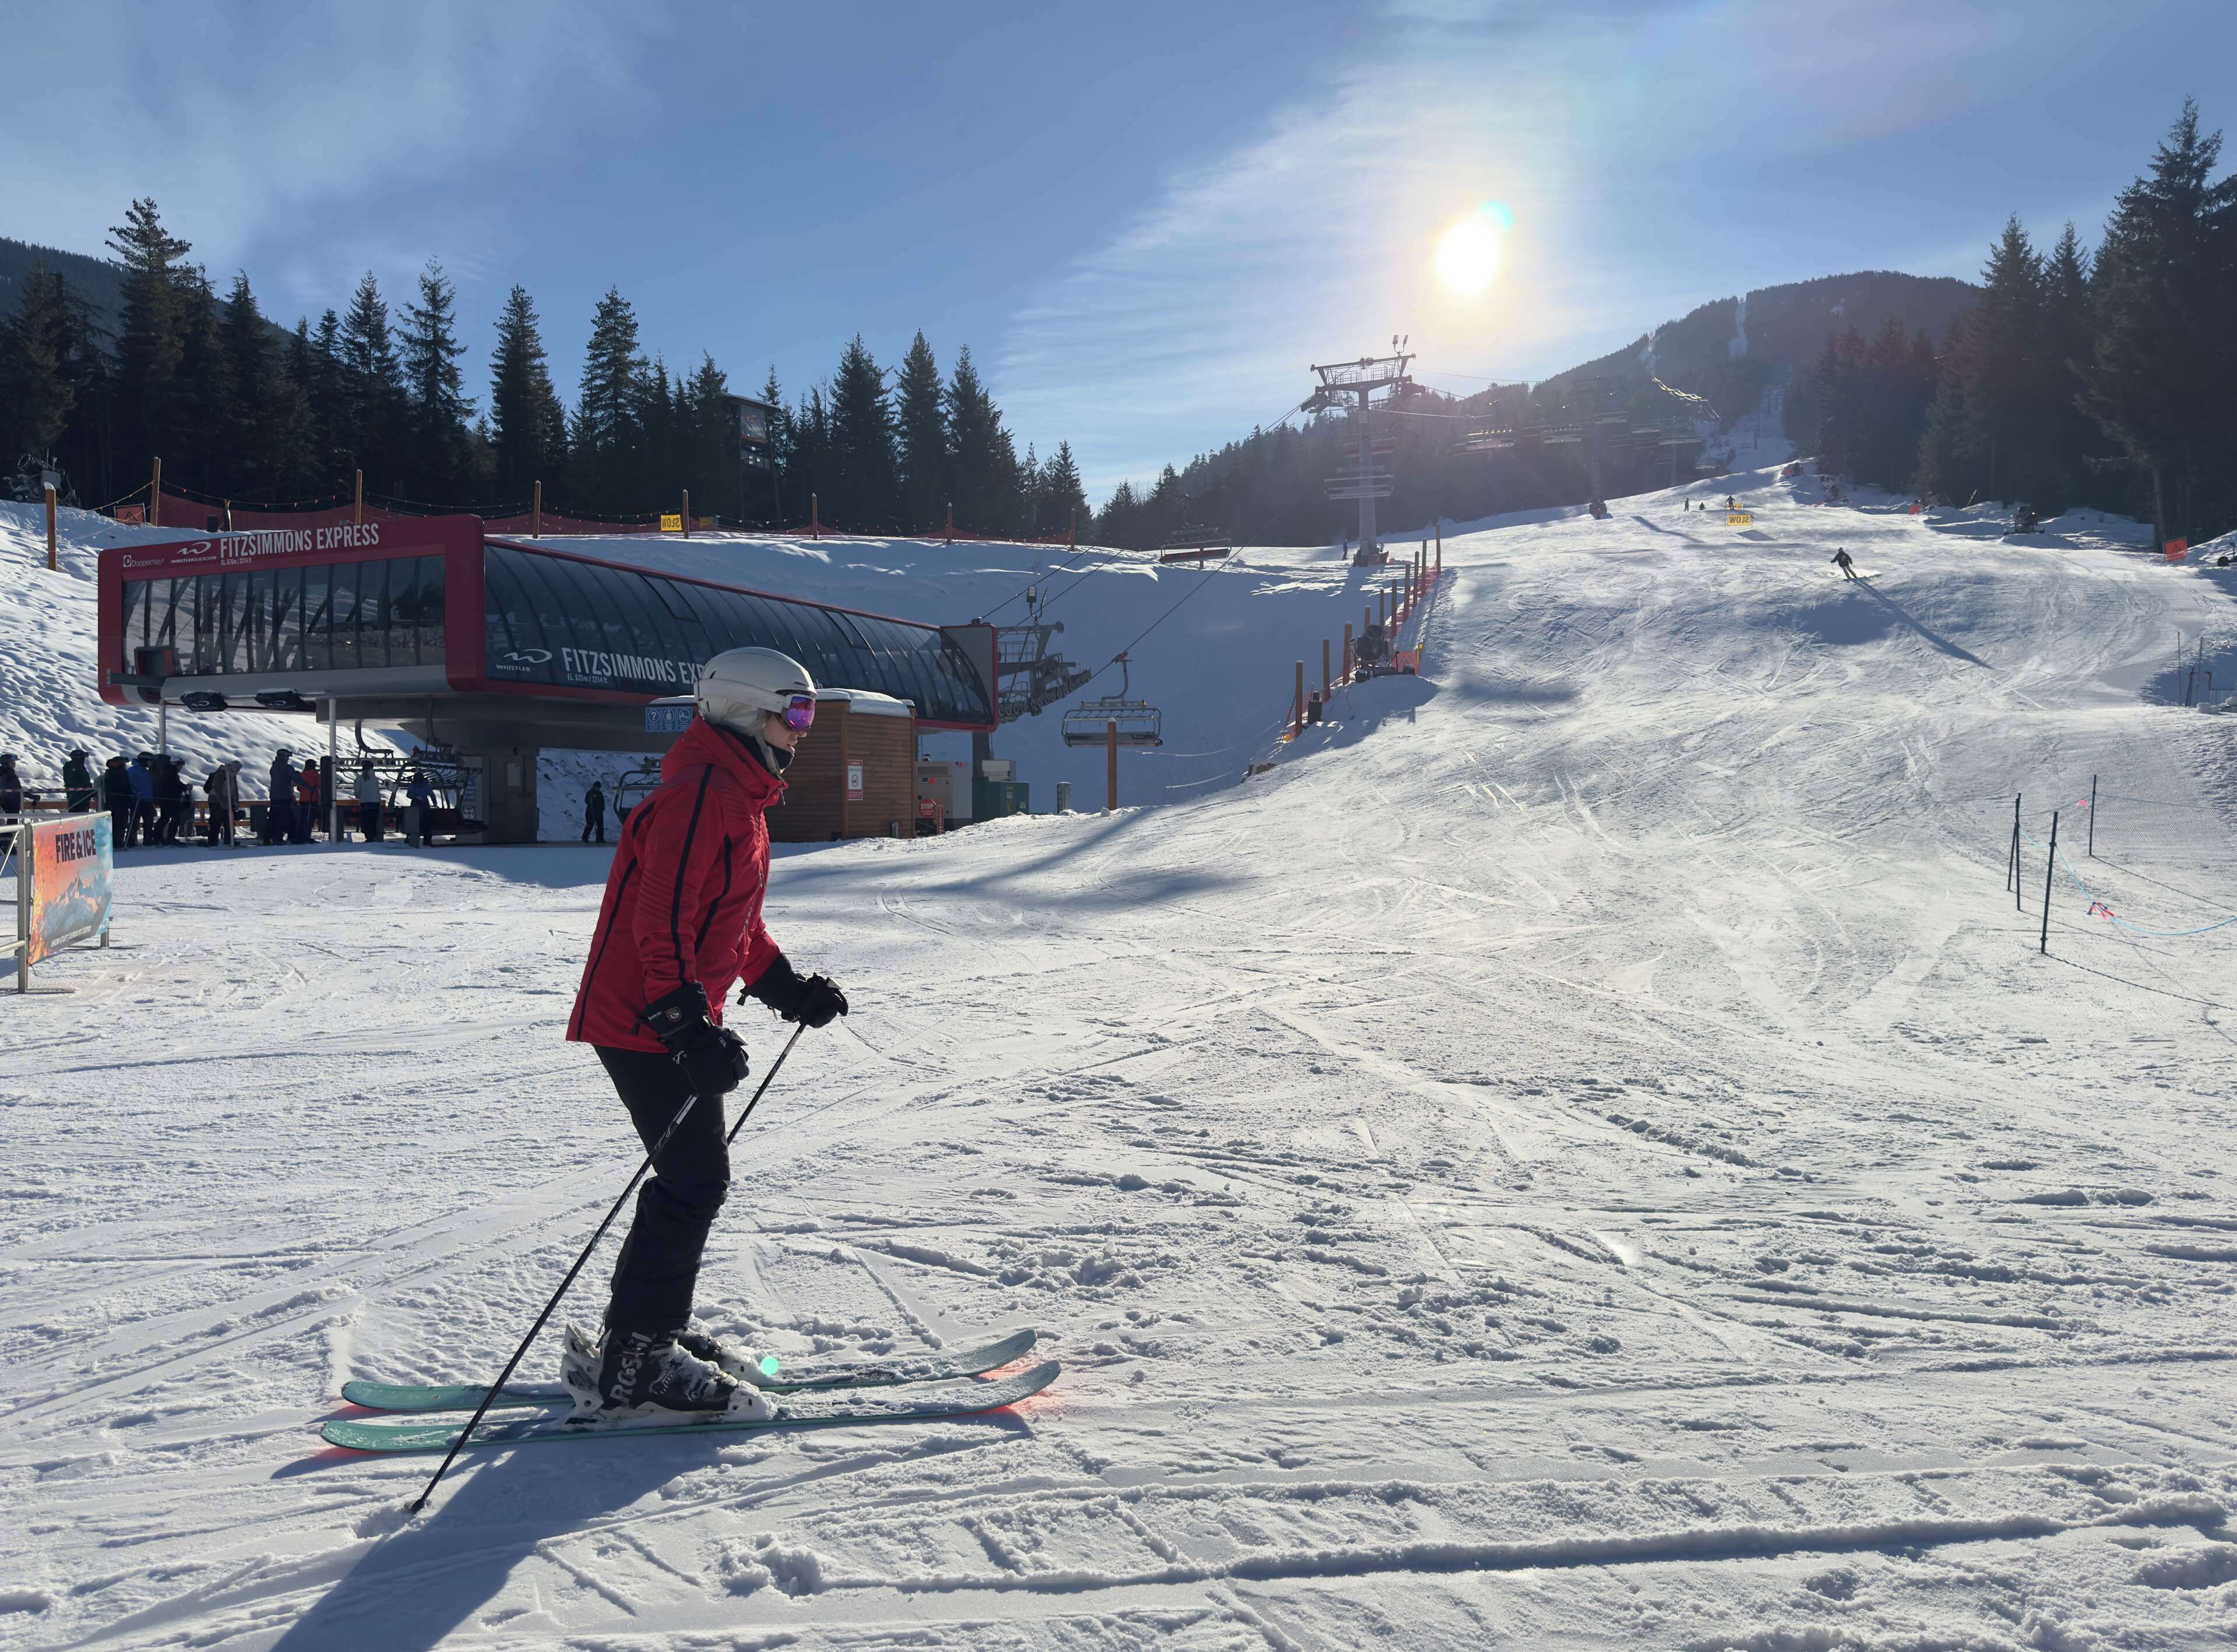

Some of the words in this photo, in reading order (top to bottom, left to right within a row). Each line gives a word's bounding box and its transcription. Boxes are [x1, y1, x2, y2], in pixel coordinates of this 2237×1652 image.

[221, 530, 312, 559] FITZSIMMONS
[317, 523, 379, 550] EXPRESS
[562, 647, 677, 683] FITZSIMMONS
[55, 833, 75, 864] FIRE
[76, 830, 83, 859] &
[83, 829, 96, 857] ICE
